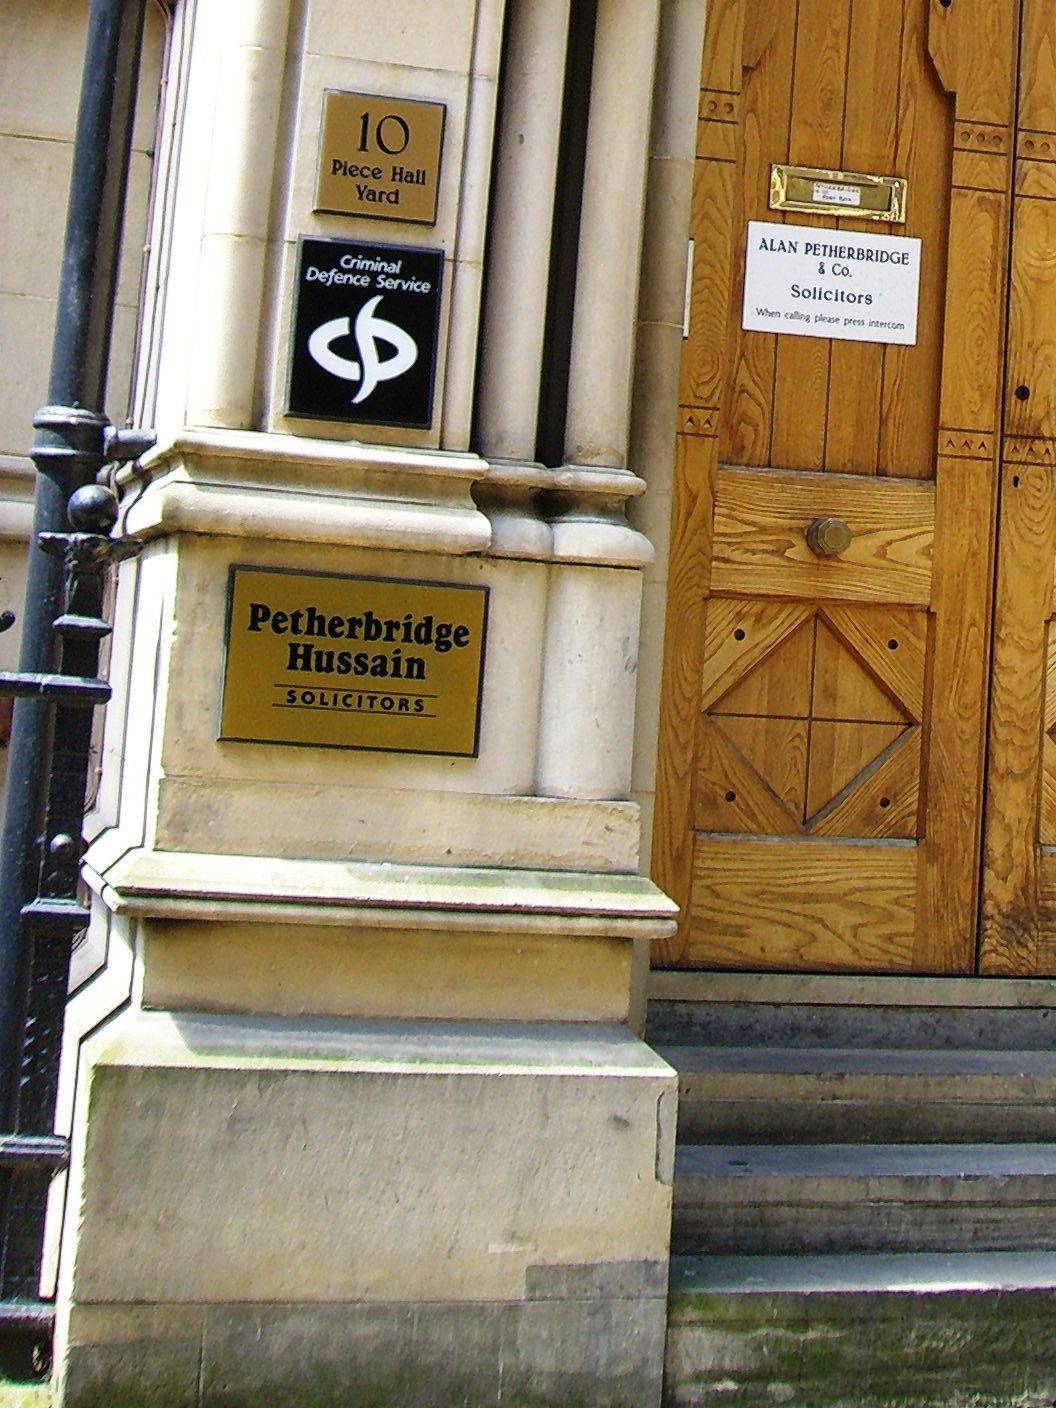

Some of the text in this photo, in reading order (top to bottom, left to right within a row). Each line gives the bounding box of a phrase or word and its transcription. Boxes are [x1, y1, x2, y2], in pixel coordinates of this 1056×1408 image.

[357, 111, 410, 155] 10
[331, 158, 427, 186] Piece Hall
[355, 184, 400, 205] Yard
[340, 253, 403, 274] Criminal
[758, 237, 911, 266] ALAN PETHERBRIDGE
[305, 266, 432, 294] Defence Service
[818, 261, 826, 275] &
[790, 283, 874, 306] Solicitors
[756, 306, 906, 331] When calling please press intercom
[247, 602, 471, 653] Petherbridge
[286, 642, 427, 680] Hussain
[285, 689, 425, 713] SOLICITORS
